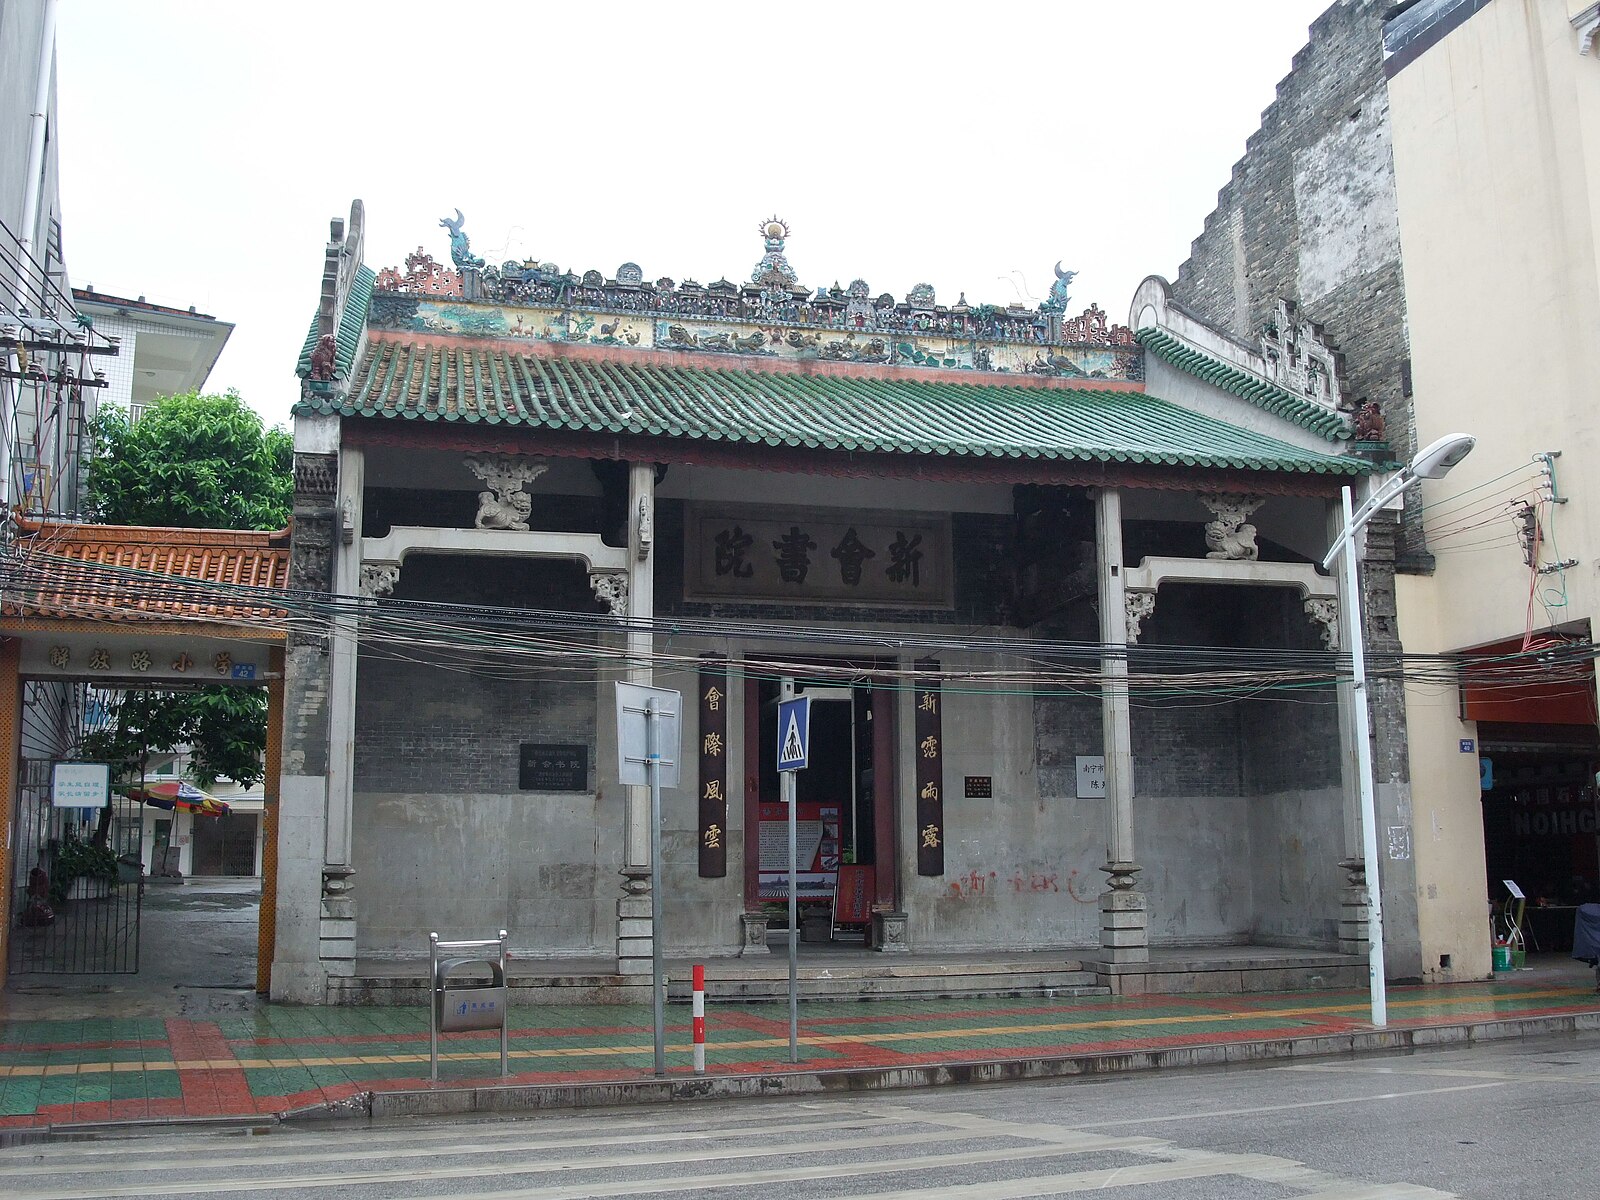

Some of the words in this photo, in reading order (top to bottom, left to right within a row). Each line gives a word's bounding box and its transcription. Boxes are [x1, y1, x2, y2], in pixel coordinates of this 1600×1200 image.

[714, 526, 924, 588] 新會書院
[49, 646, 231, 675] 解放路小学
[238, 670, 249, 678] 42
[527, 759, 581, 769] 新会书院
[1083, 764, 1104, 773] 南宁市
